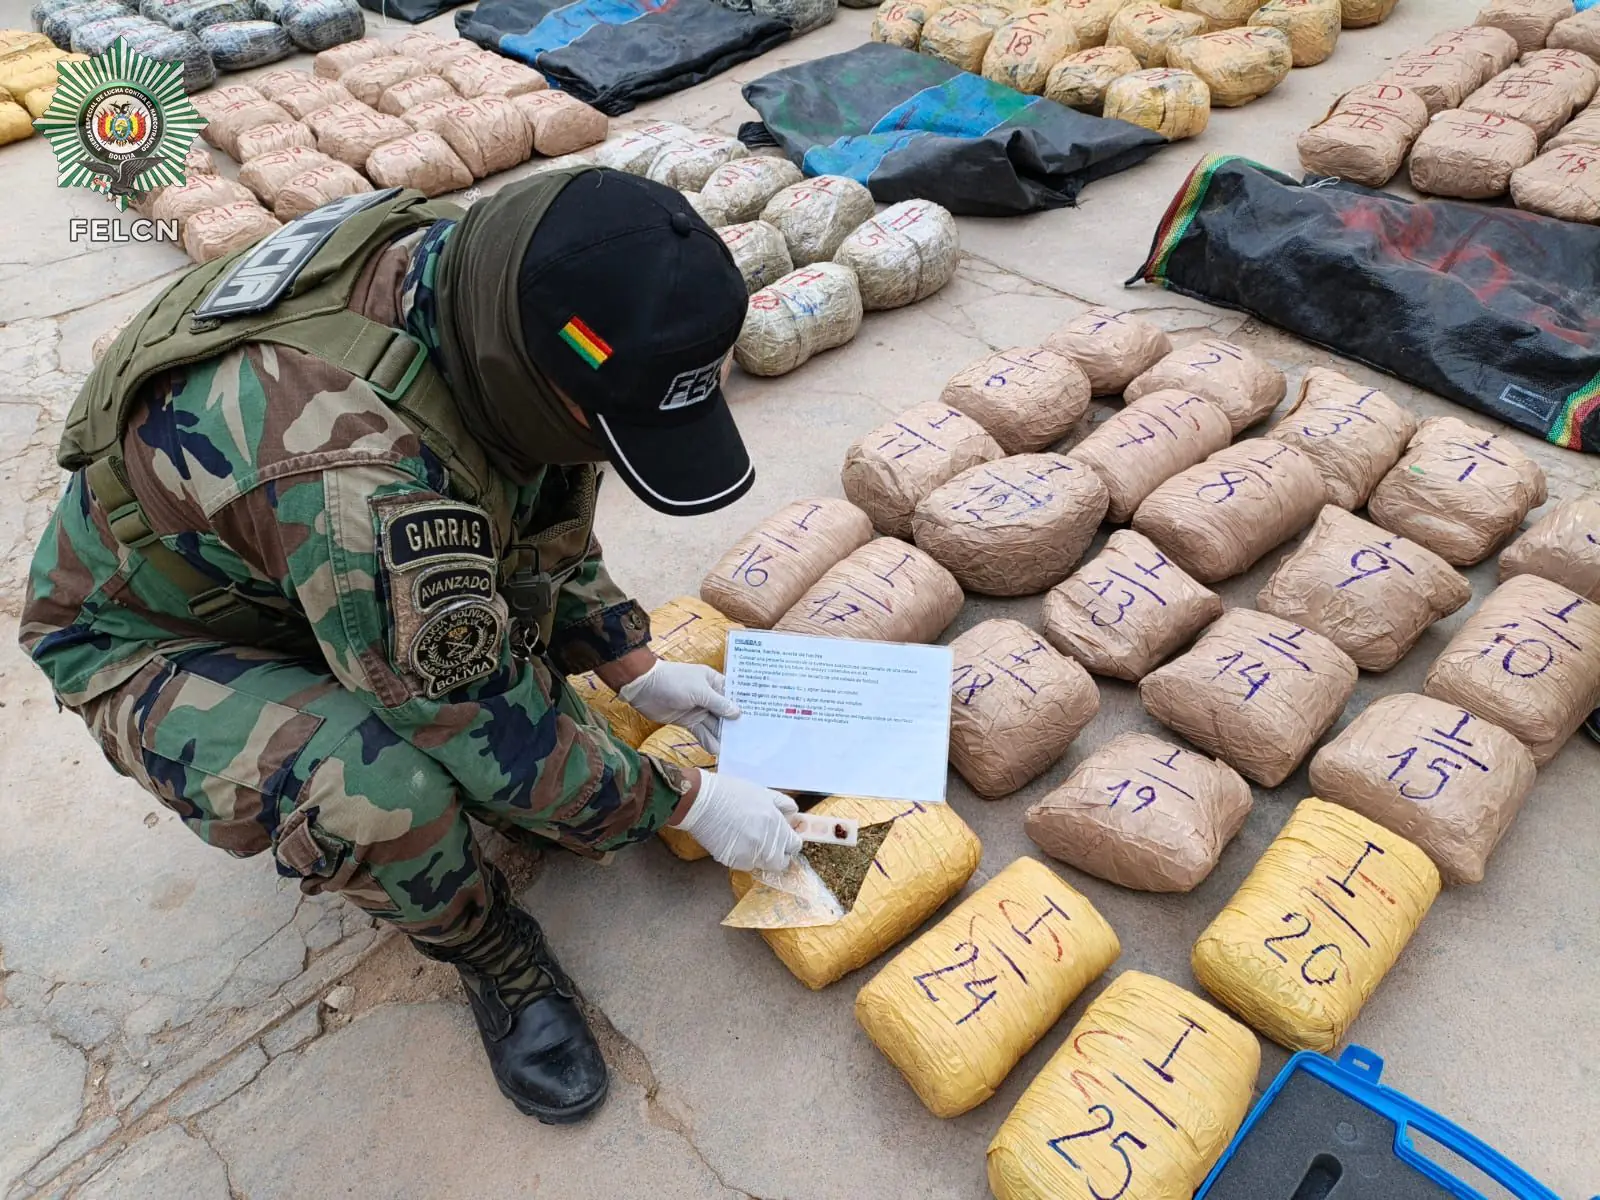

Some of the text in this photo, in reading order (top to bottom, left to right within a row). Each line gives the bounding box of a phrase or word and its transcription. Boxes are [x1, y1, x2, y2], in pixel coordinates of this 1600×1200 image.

[1005, 31, 1035, 57] 18
[1376, 84, 1404, 101] D
[1483, 113, 1506, 128] D
[890, 207, 925, 231] H
[1190, 352, 1222, 373] 2
[1303, 418, 1352, 437] 3
[1197, 471, 1248, 503] 8
[405, 518, 481, 551] GARRAS
[731, 544, 774, 587] 16
[1336, 550, 1391, 588] 9
[421, 575, 490, 601] AVANZADO
[1087, 579, 1136, 627] 13
[808, 590, 862, 625] 17
[436, 661, 491, 691] BOLIVIA
[951, 664, 994, 705] 18
[1210, 651, 1271, 702] 14
[1387, 747, 1462, 800] 15
[1106, 780, 1156, 813] 19
[1264, 912, 1345, 986] 20
[913, 941, 998, 1025] 24
[1047, 1104, 1147, 1200] 25
